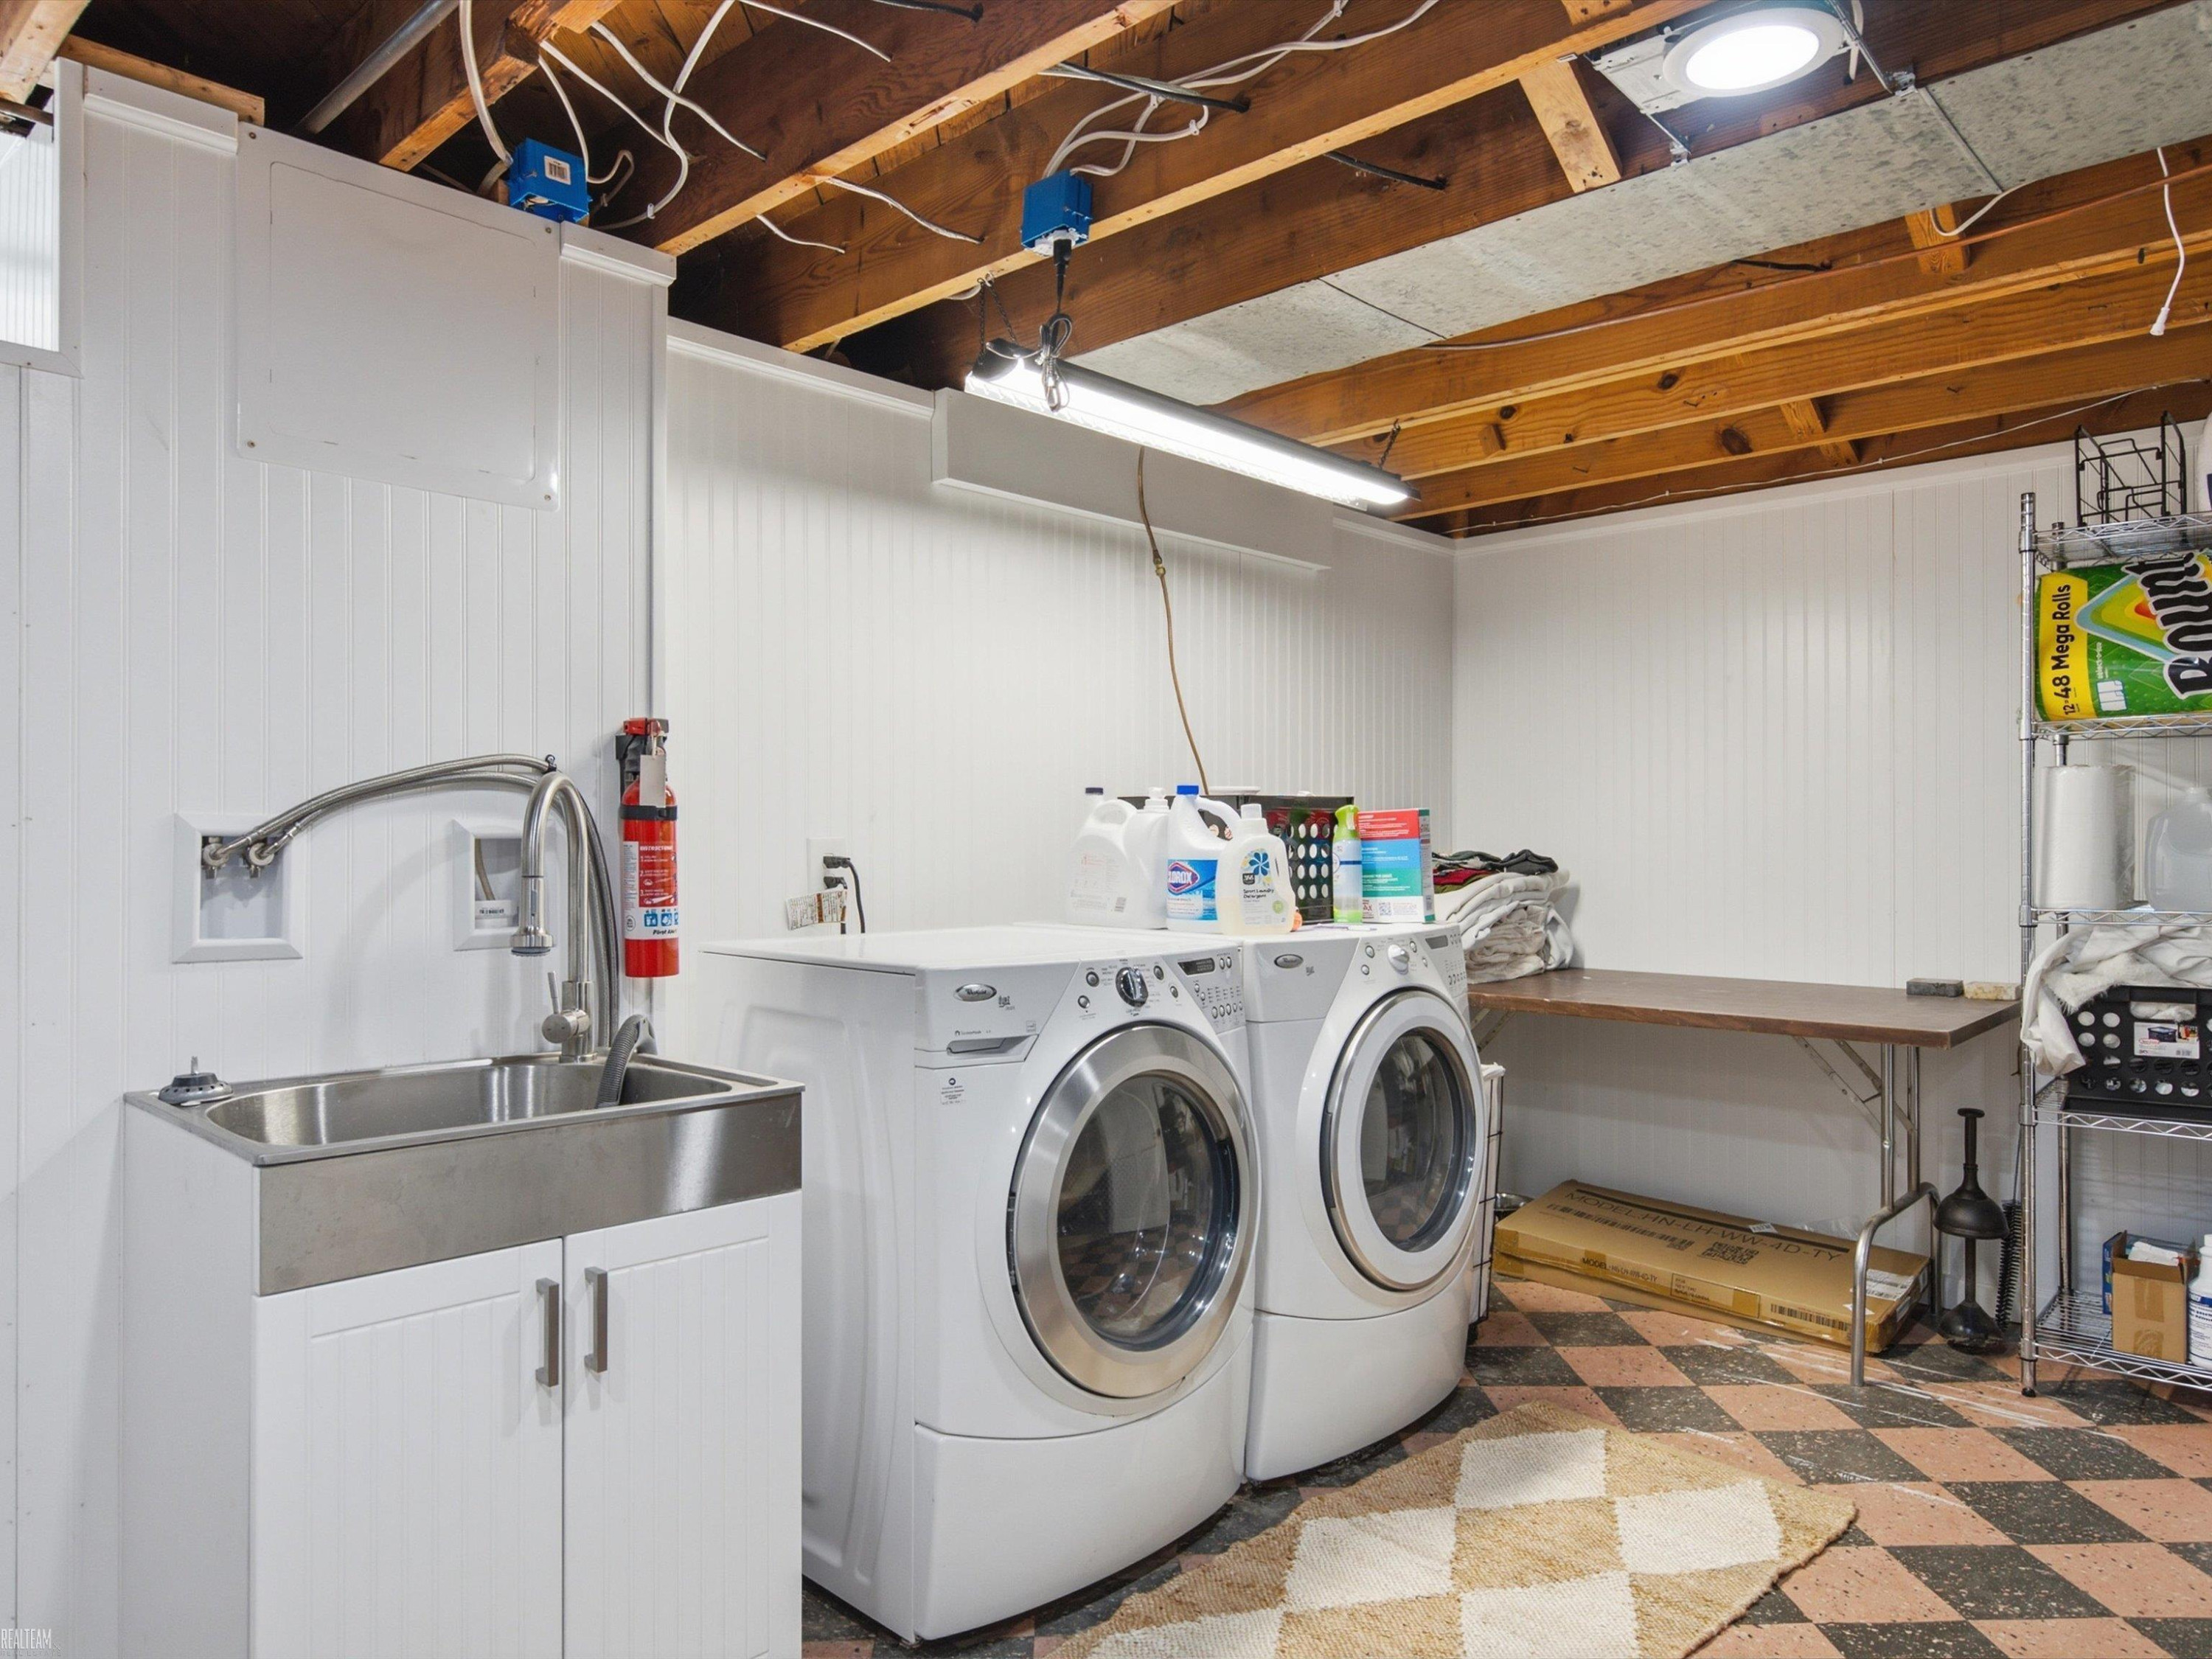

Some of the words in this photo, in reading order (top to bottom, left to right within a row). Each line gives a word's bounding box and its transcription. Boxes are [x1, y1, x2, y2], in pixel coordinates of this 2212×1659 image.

[2052, 584, 2071, 620] Rolls
[2051, 625, 2075, 670] Mega
[1168, 871, 1192, 884] LOROX
